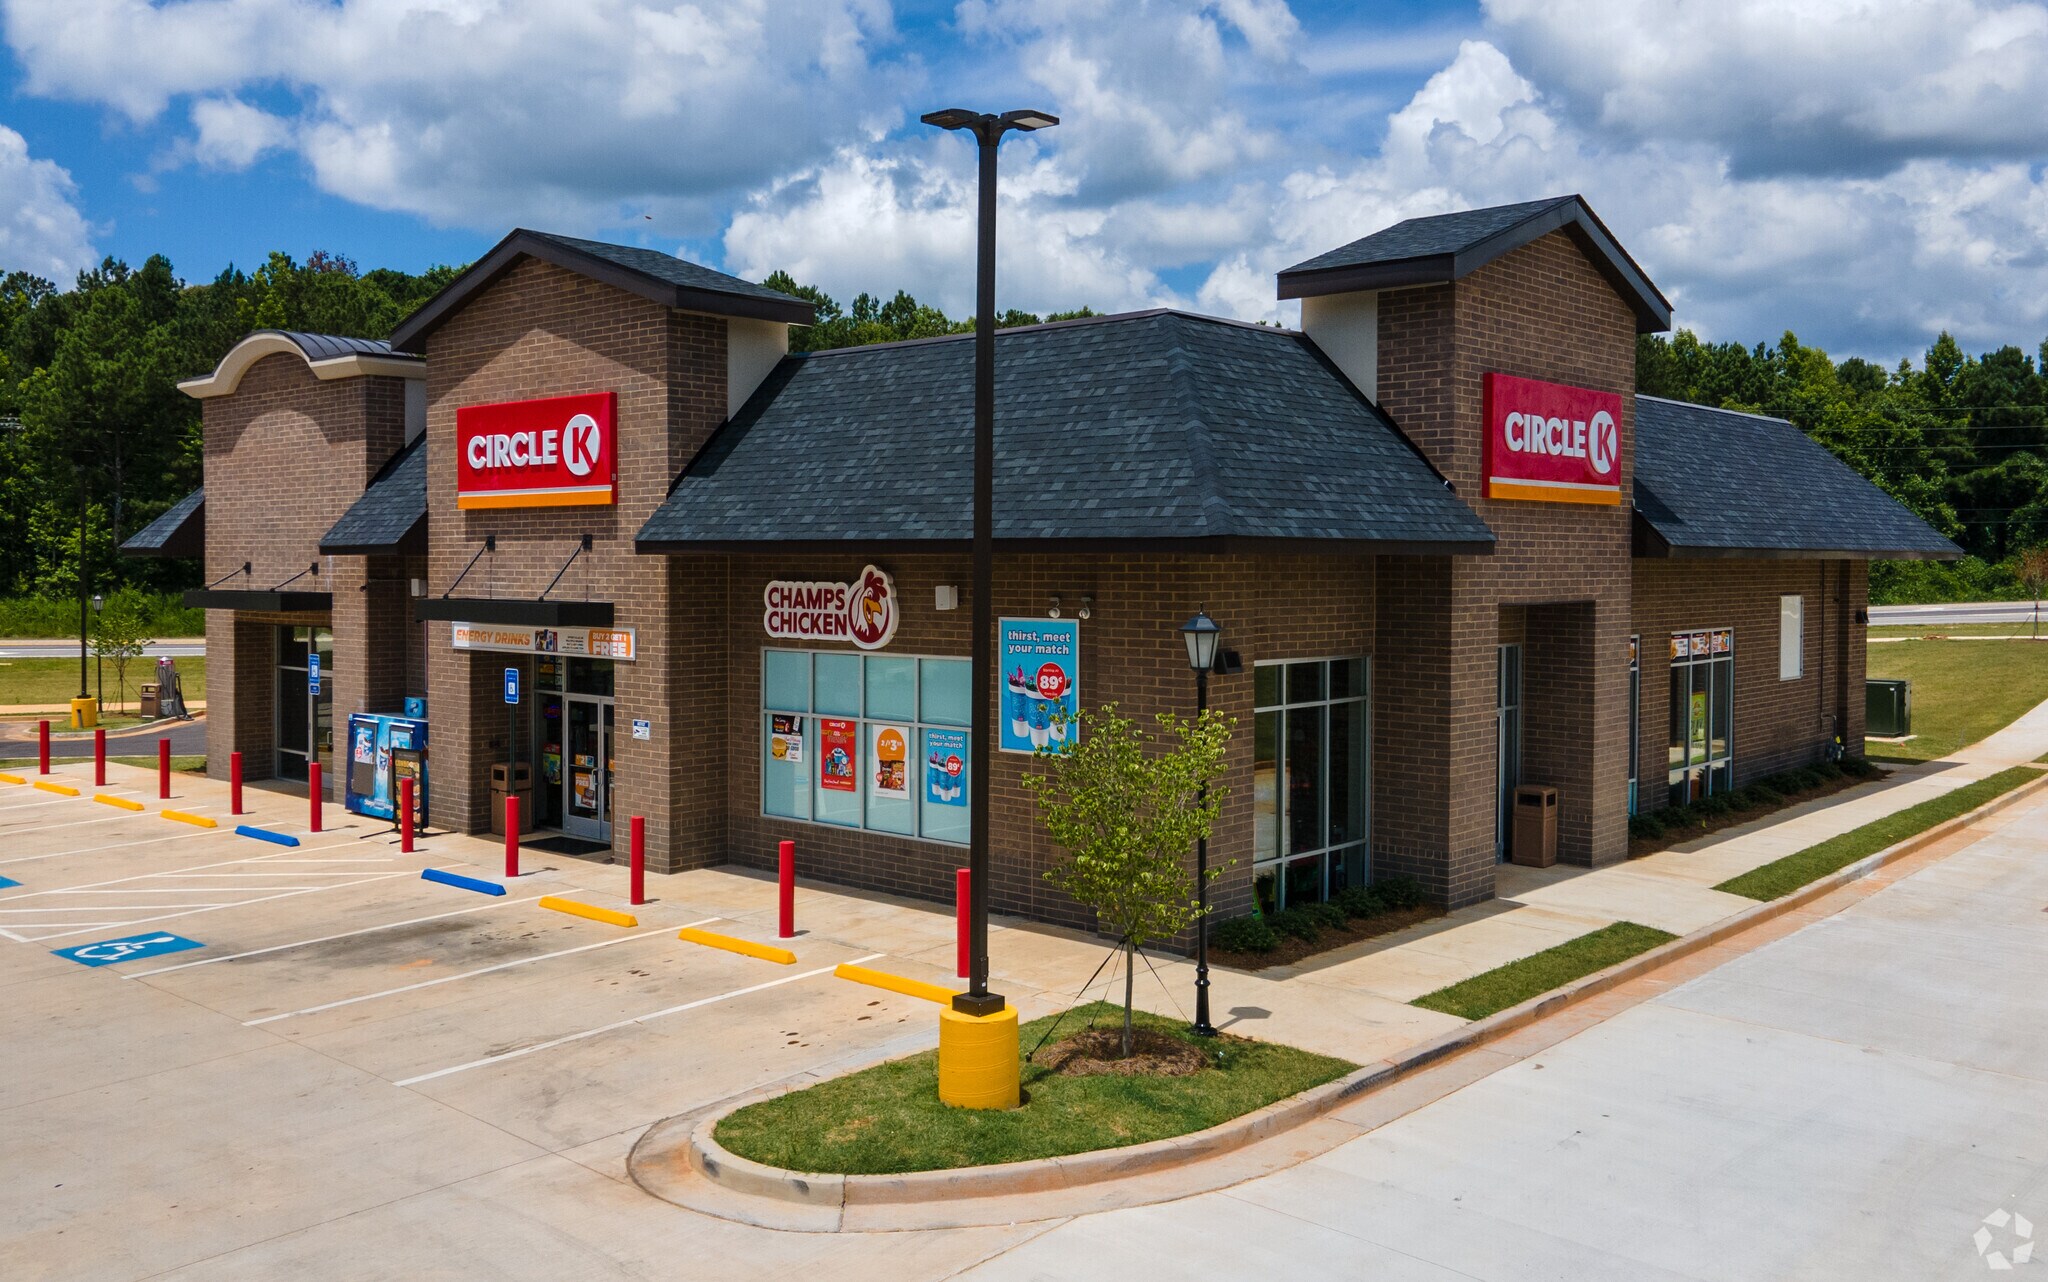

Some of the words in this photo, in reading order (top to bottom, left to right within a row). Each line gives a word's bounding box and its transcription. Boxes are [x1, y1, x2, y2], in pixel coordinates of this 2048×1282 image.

[467, 429, 558, 470] CIRCLE
[570, 424, 598, 473] K
[1504, 411, 1586, 458] CIRCLE
[1595, 419, 1615, 472] K
[768, 586, 846, 611] CHAMPS
[767, 610, 847, 636] CHICKEN
[456, 629, 493, 643] ENERGY
[494, 632, 531, 646] DRINKS
[592, 632, 605, 640] BUY
[605, 633, 610, 641] 2
[610, 633, 622, 641] GET
[623, 633, 627, 641] 1
[1008, 630, 1040, 643] thirst,
[1042, 632, 1071, 643] meet
[592, 640, 627, 657] FREE
[1008, 644, 1033, 654] your
[1035, 644, 1069, 655] match
[928, 732, 947, 741] thirst,
